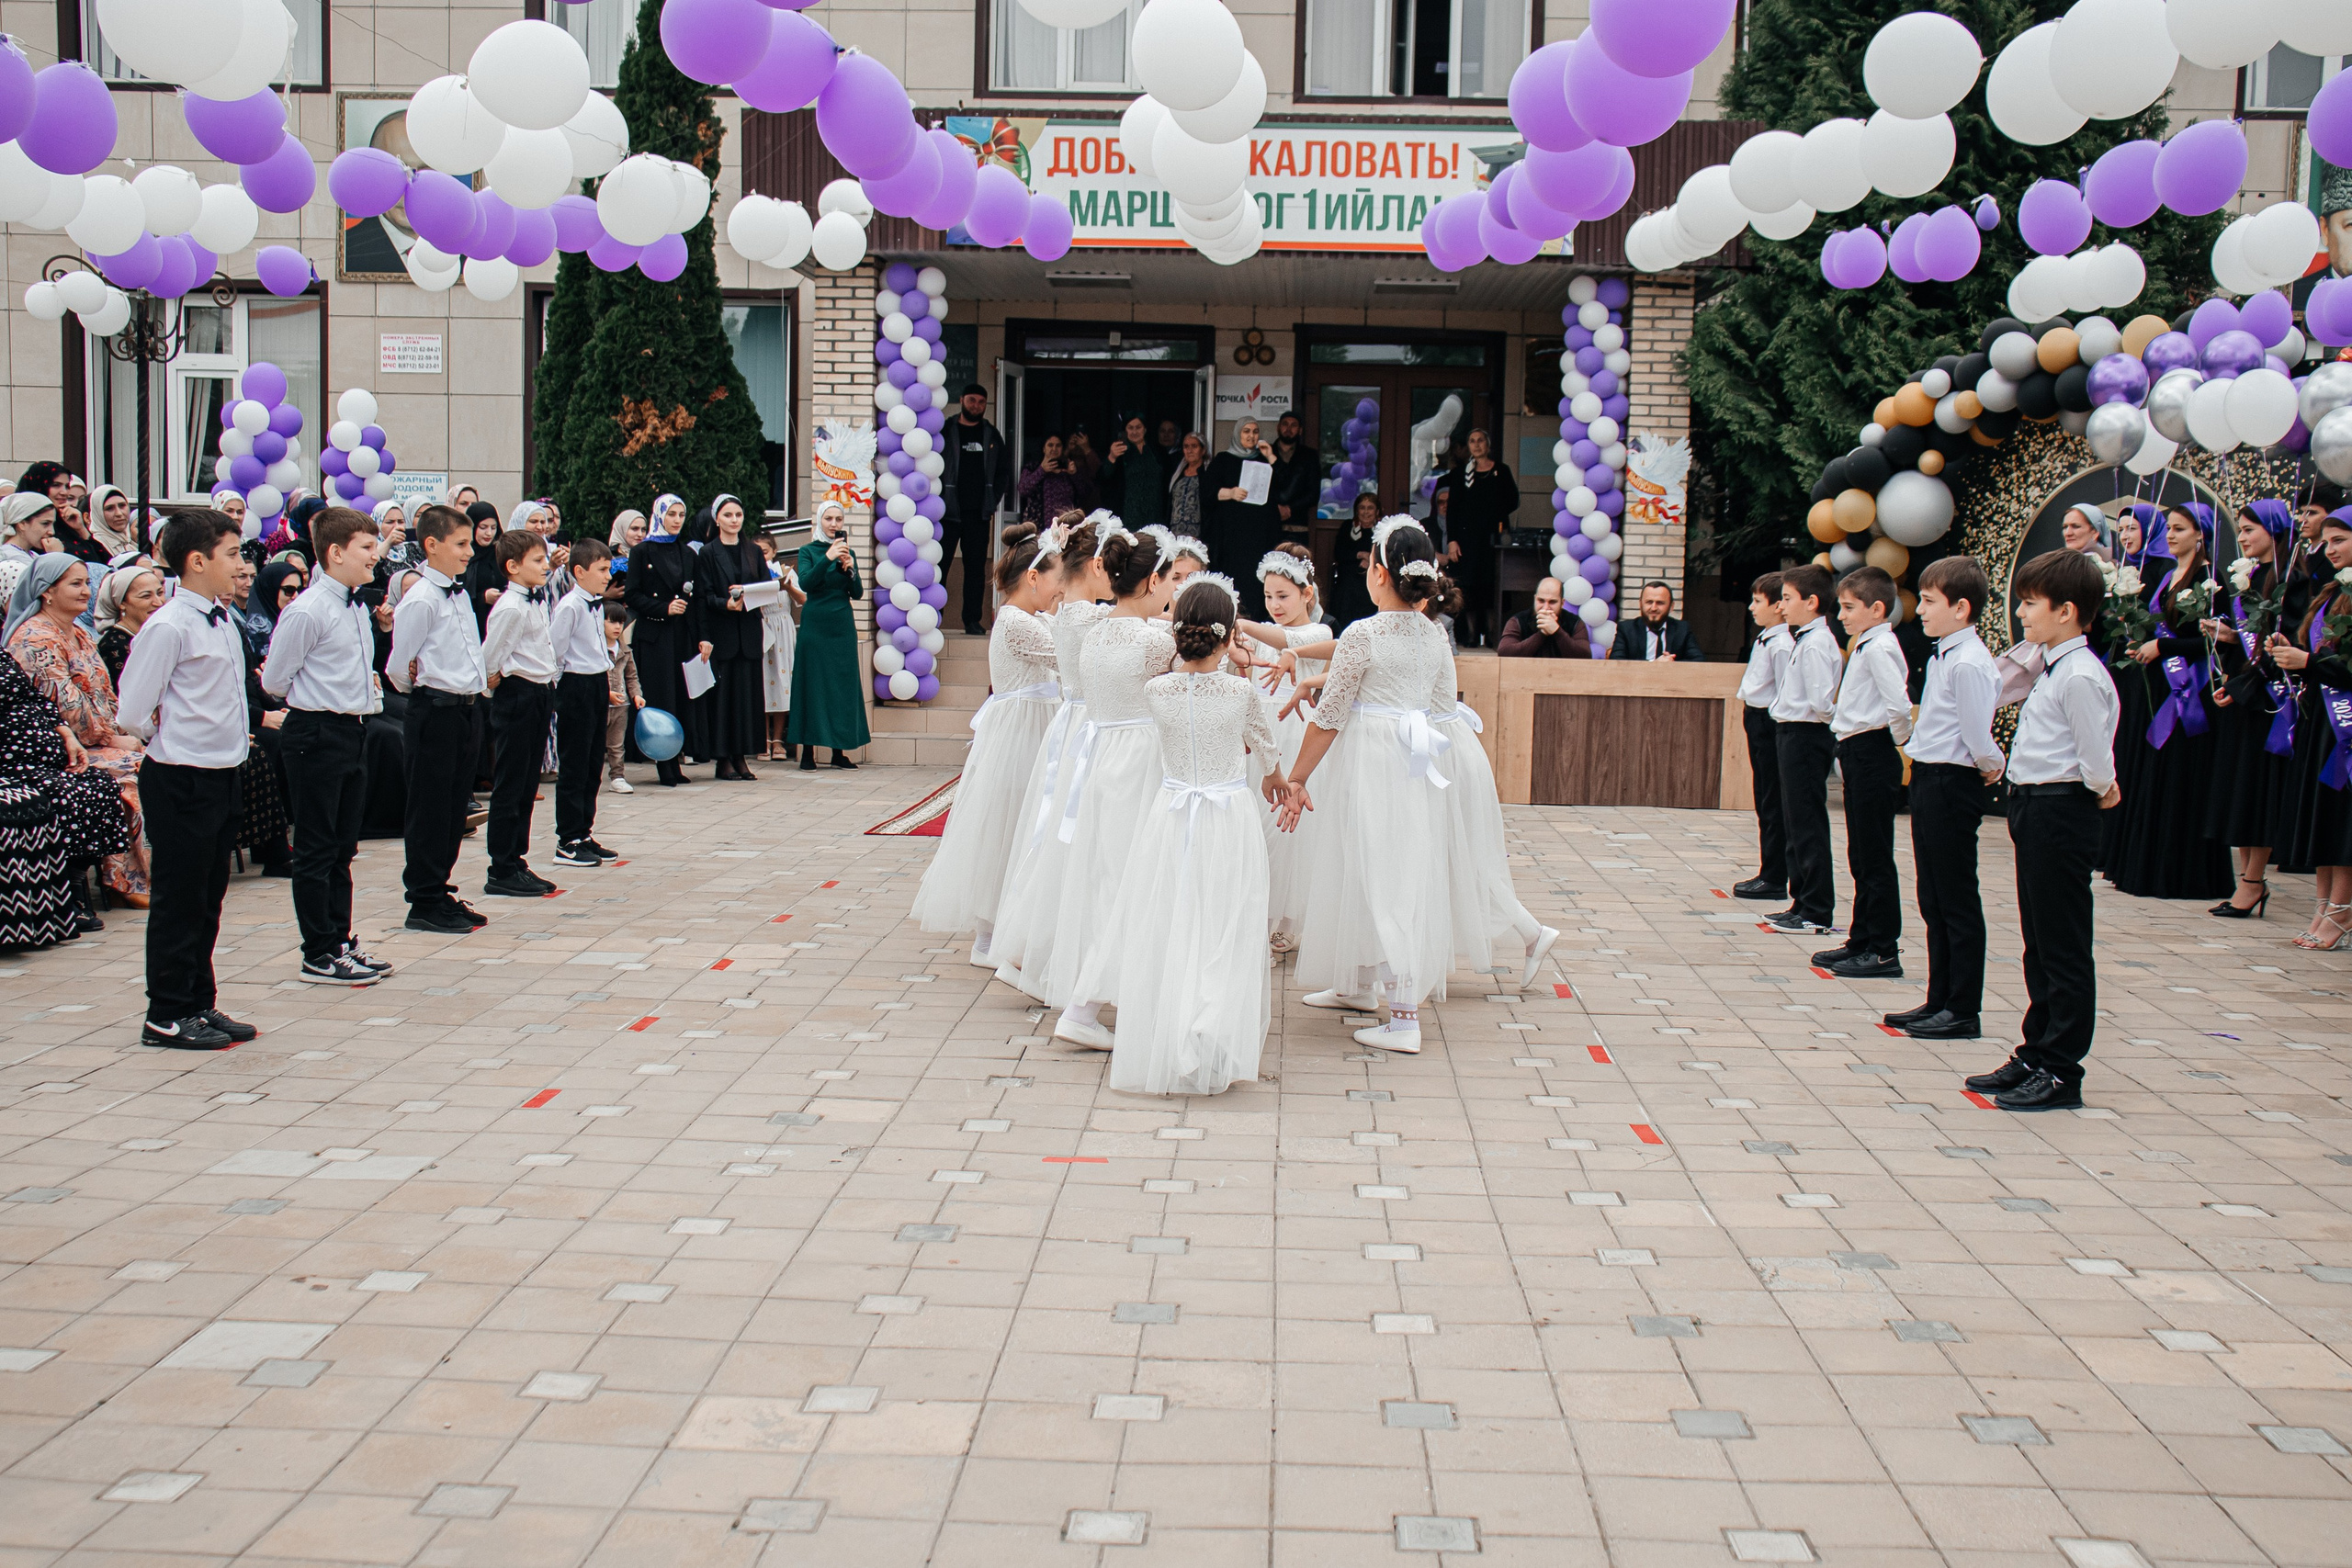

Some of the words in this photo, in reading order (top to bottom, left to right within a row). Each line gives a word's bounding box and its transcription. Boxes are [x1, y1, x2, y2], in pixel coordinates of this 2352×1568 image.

[1046, 137, 1136, 177] ДОБ
[1216, 395, 1245, 403] ТОЧКА
[1261, 395, 1289, 403] РОСТА
